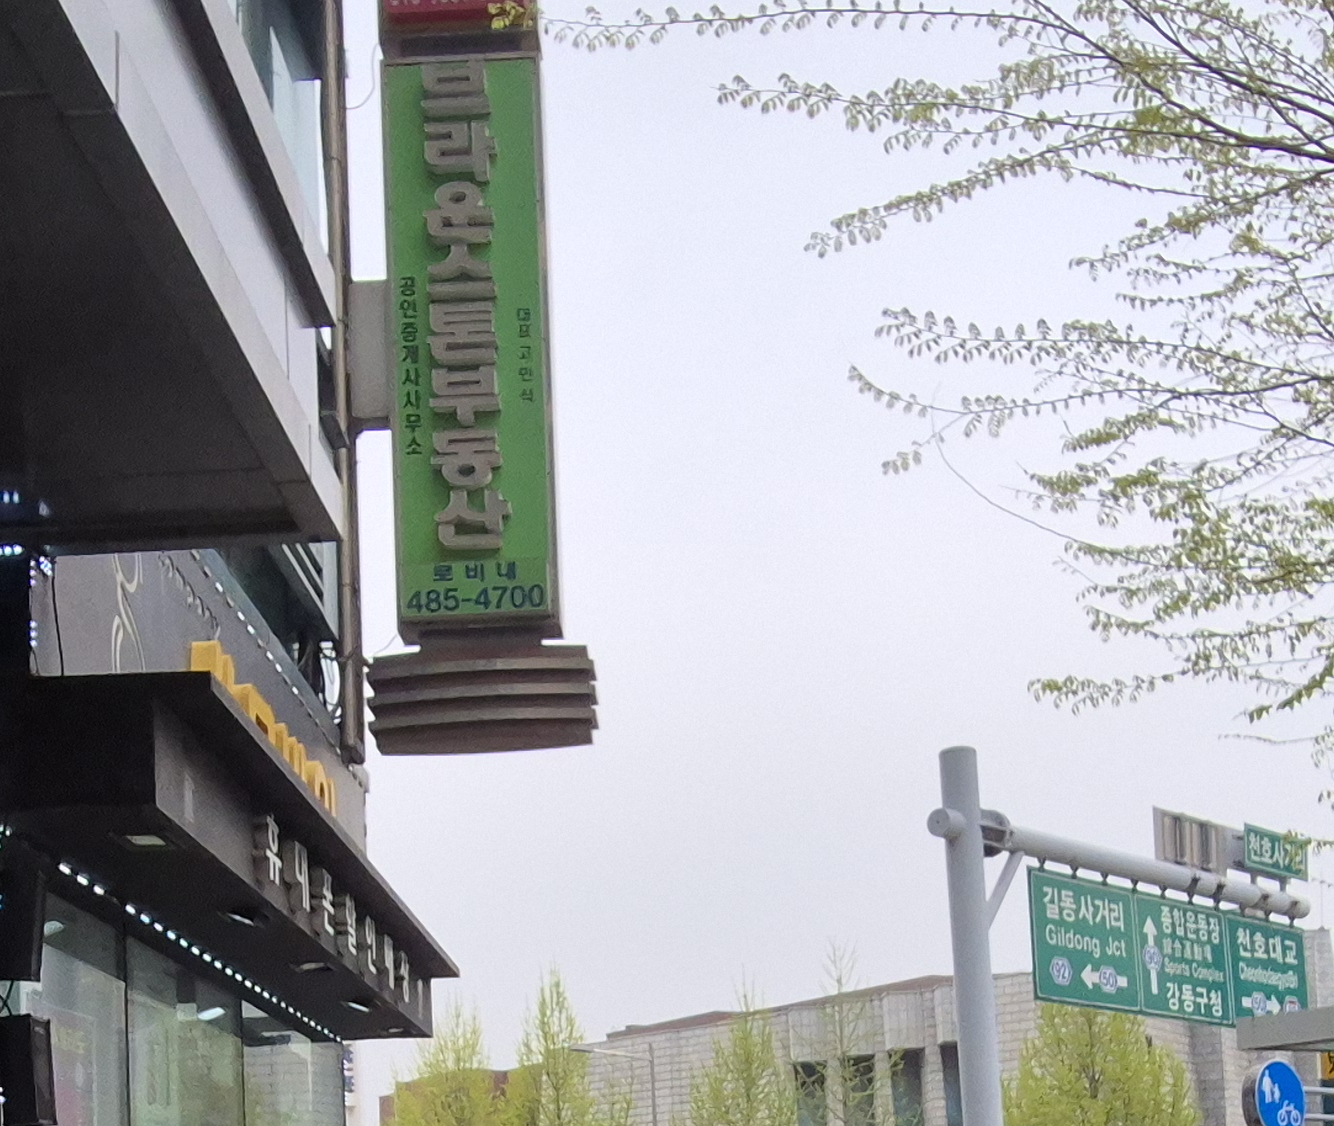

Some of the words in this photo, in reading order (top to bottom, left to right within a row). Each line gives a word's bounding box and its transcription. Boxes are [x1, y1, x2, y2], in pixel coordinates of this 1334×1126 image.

[421, 60, 513, 550] 브라운스톤부동산
[399, 276, 423, 456] 공인중개사사무소
[405, 583, 545, 614] 485-4700
[265, 812, 411, 1004] 휴대폰할인매장
[1042, 885, 1125, 933] 길동사거리
[1160, 905, 1220, 945] 종합운동장
[1045, 923, 1101, 959] Gildong
[1105, 935, 1127, 958] Jct
[1235, 926, 1299, 966] 천호대교
[1053, 960, 1069, 981] 92
[1101, 970, 1116, 988] 50
[1166, 981, 1223, 1017] 강동구청
